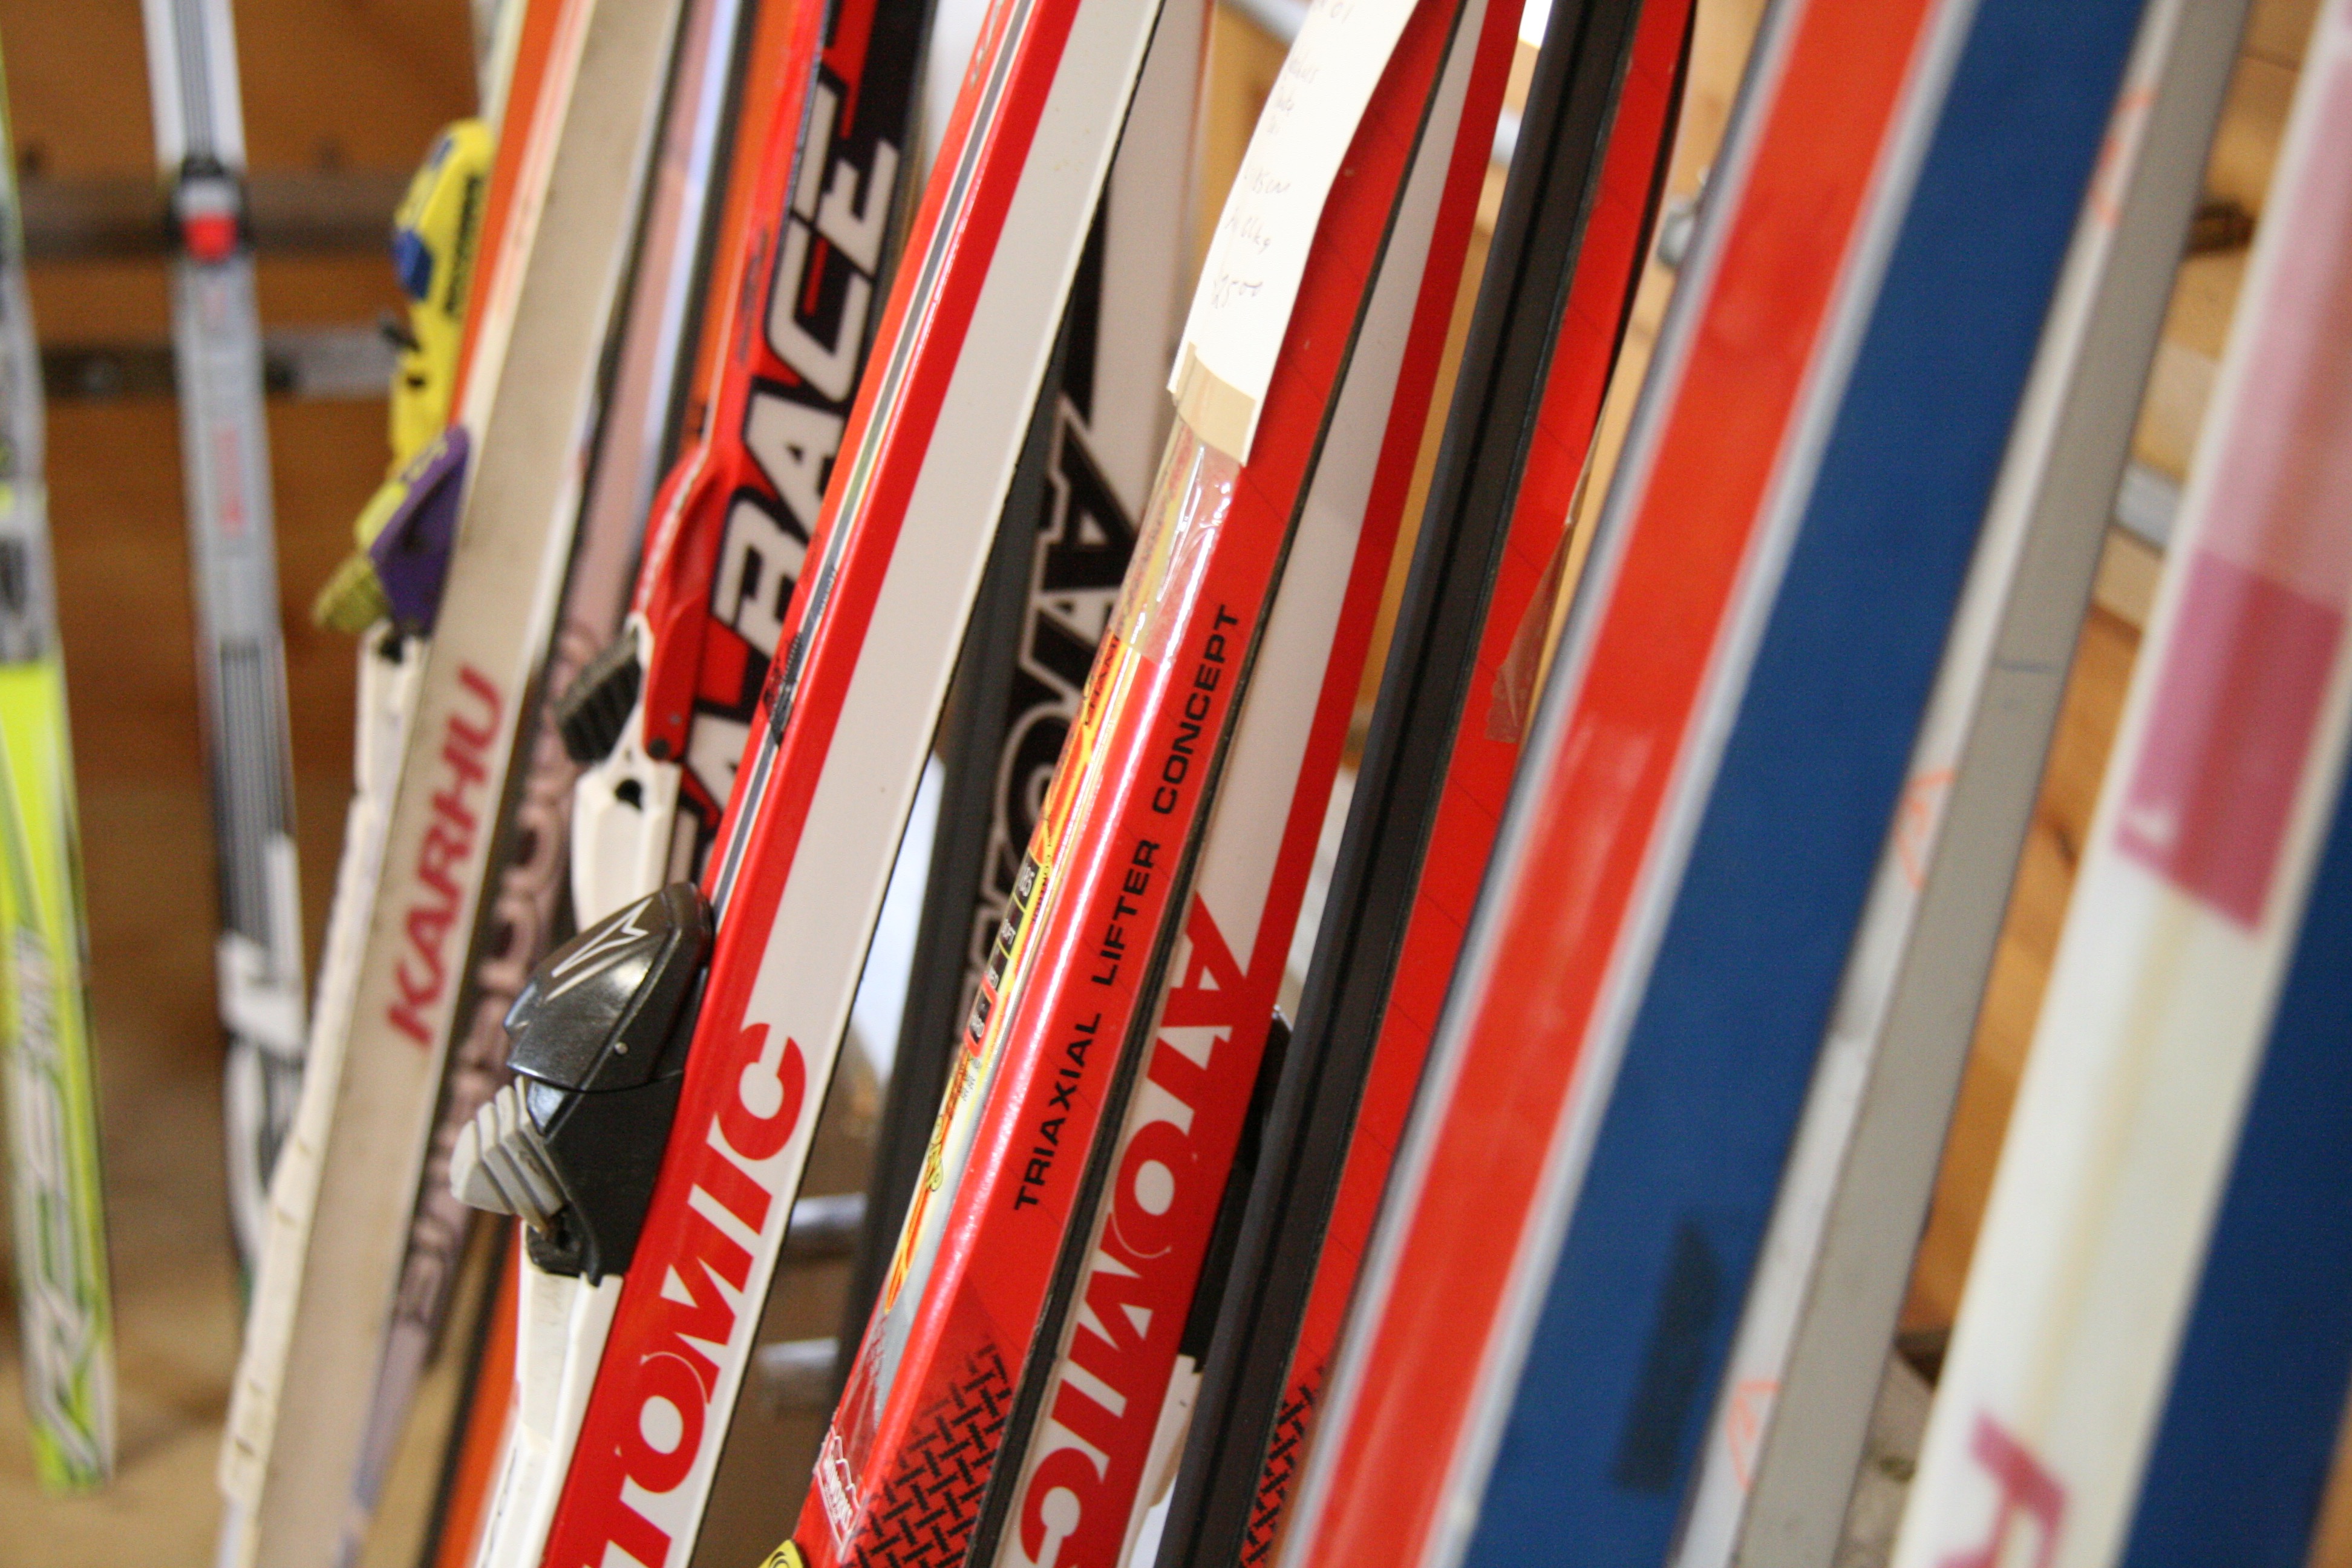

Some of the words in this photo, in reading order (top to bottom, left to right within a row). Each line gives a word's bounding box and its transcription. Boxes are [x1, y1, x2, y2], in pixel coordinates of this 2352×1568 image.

[712, 82, 900, 661] RACE
[385, 664, 506, 1047] KARHU
[1014, 1013, 1102, 1210] TRIAXIAL
[1091, 839, 1161, 987] LIFTER
[1151, 604, 1238, 815] CONCEPT
[586, 1022, 807, 1568] TOMIC
[1020, 890, 1251, 1568] ATOMIC
